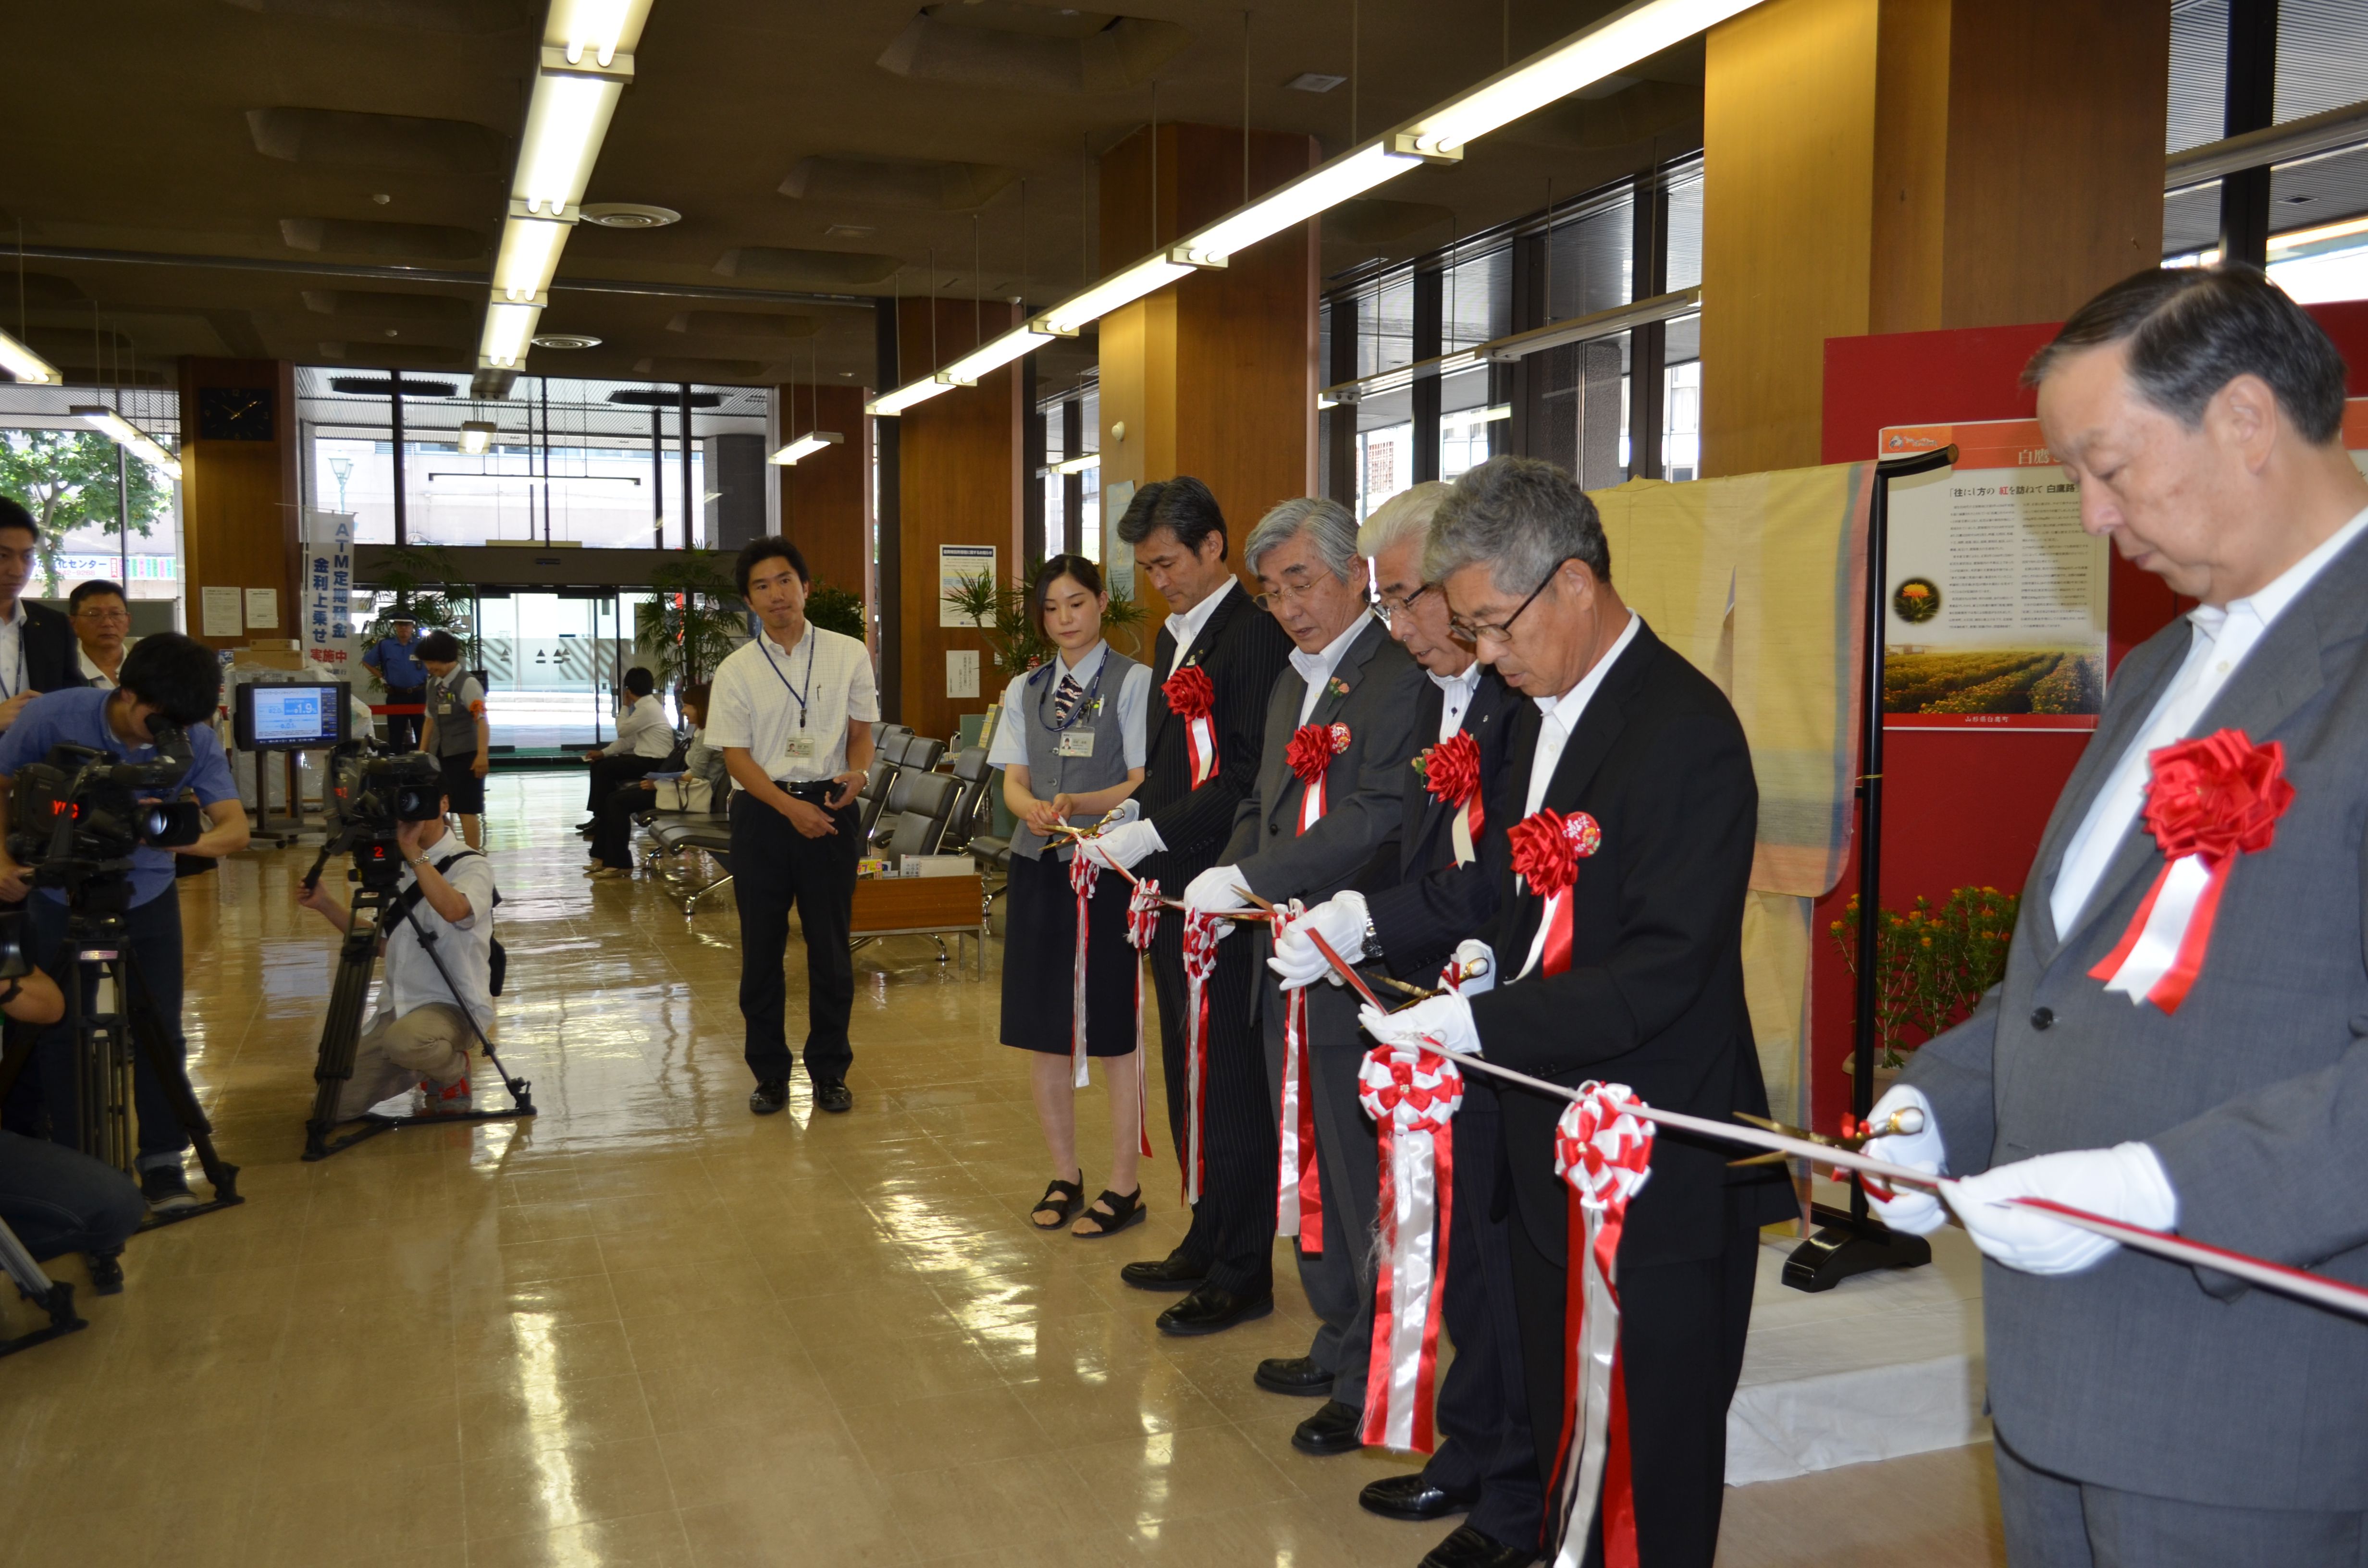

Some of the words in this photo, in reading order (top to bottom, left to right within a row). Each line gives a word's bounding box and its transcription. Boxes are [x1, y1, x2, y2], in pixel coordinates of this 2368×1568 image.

[2019, 448, 2061, 465] 白鷹
[312, 557, 329, 643] 金利上乗せ
[332, 523, 350, 638] ATM定期預金
[310, 648, 347, 663] 実施中
